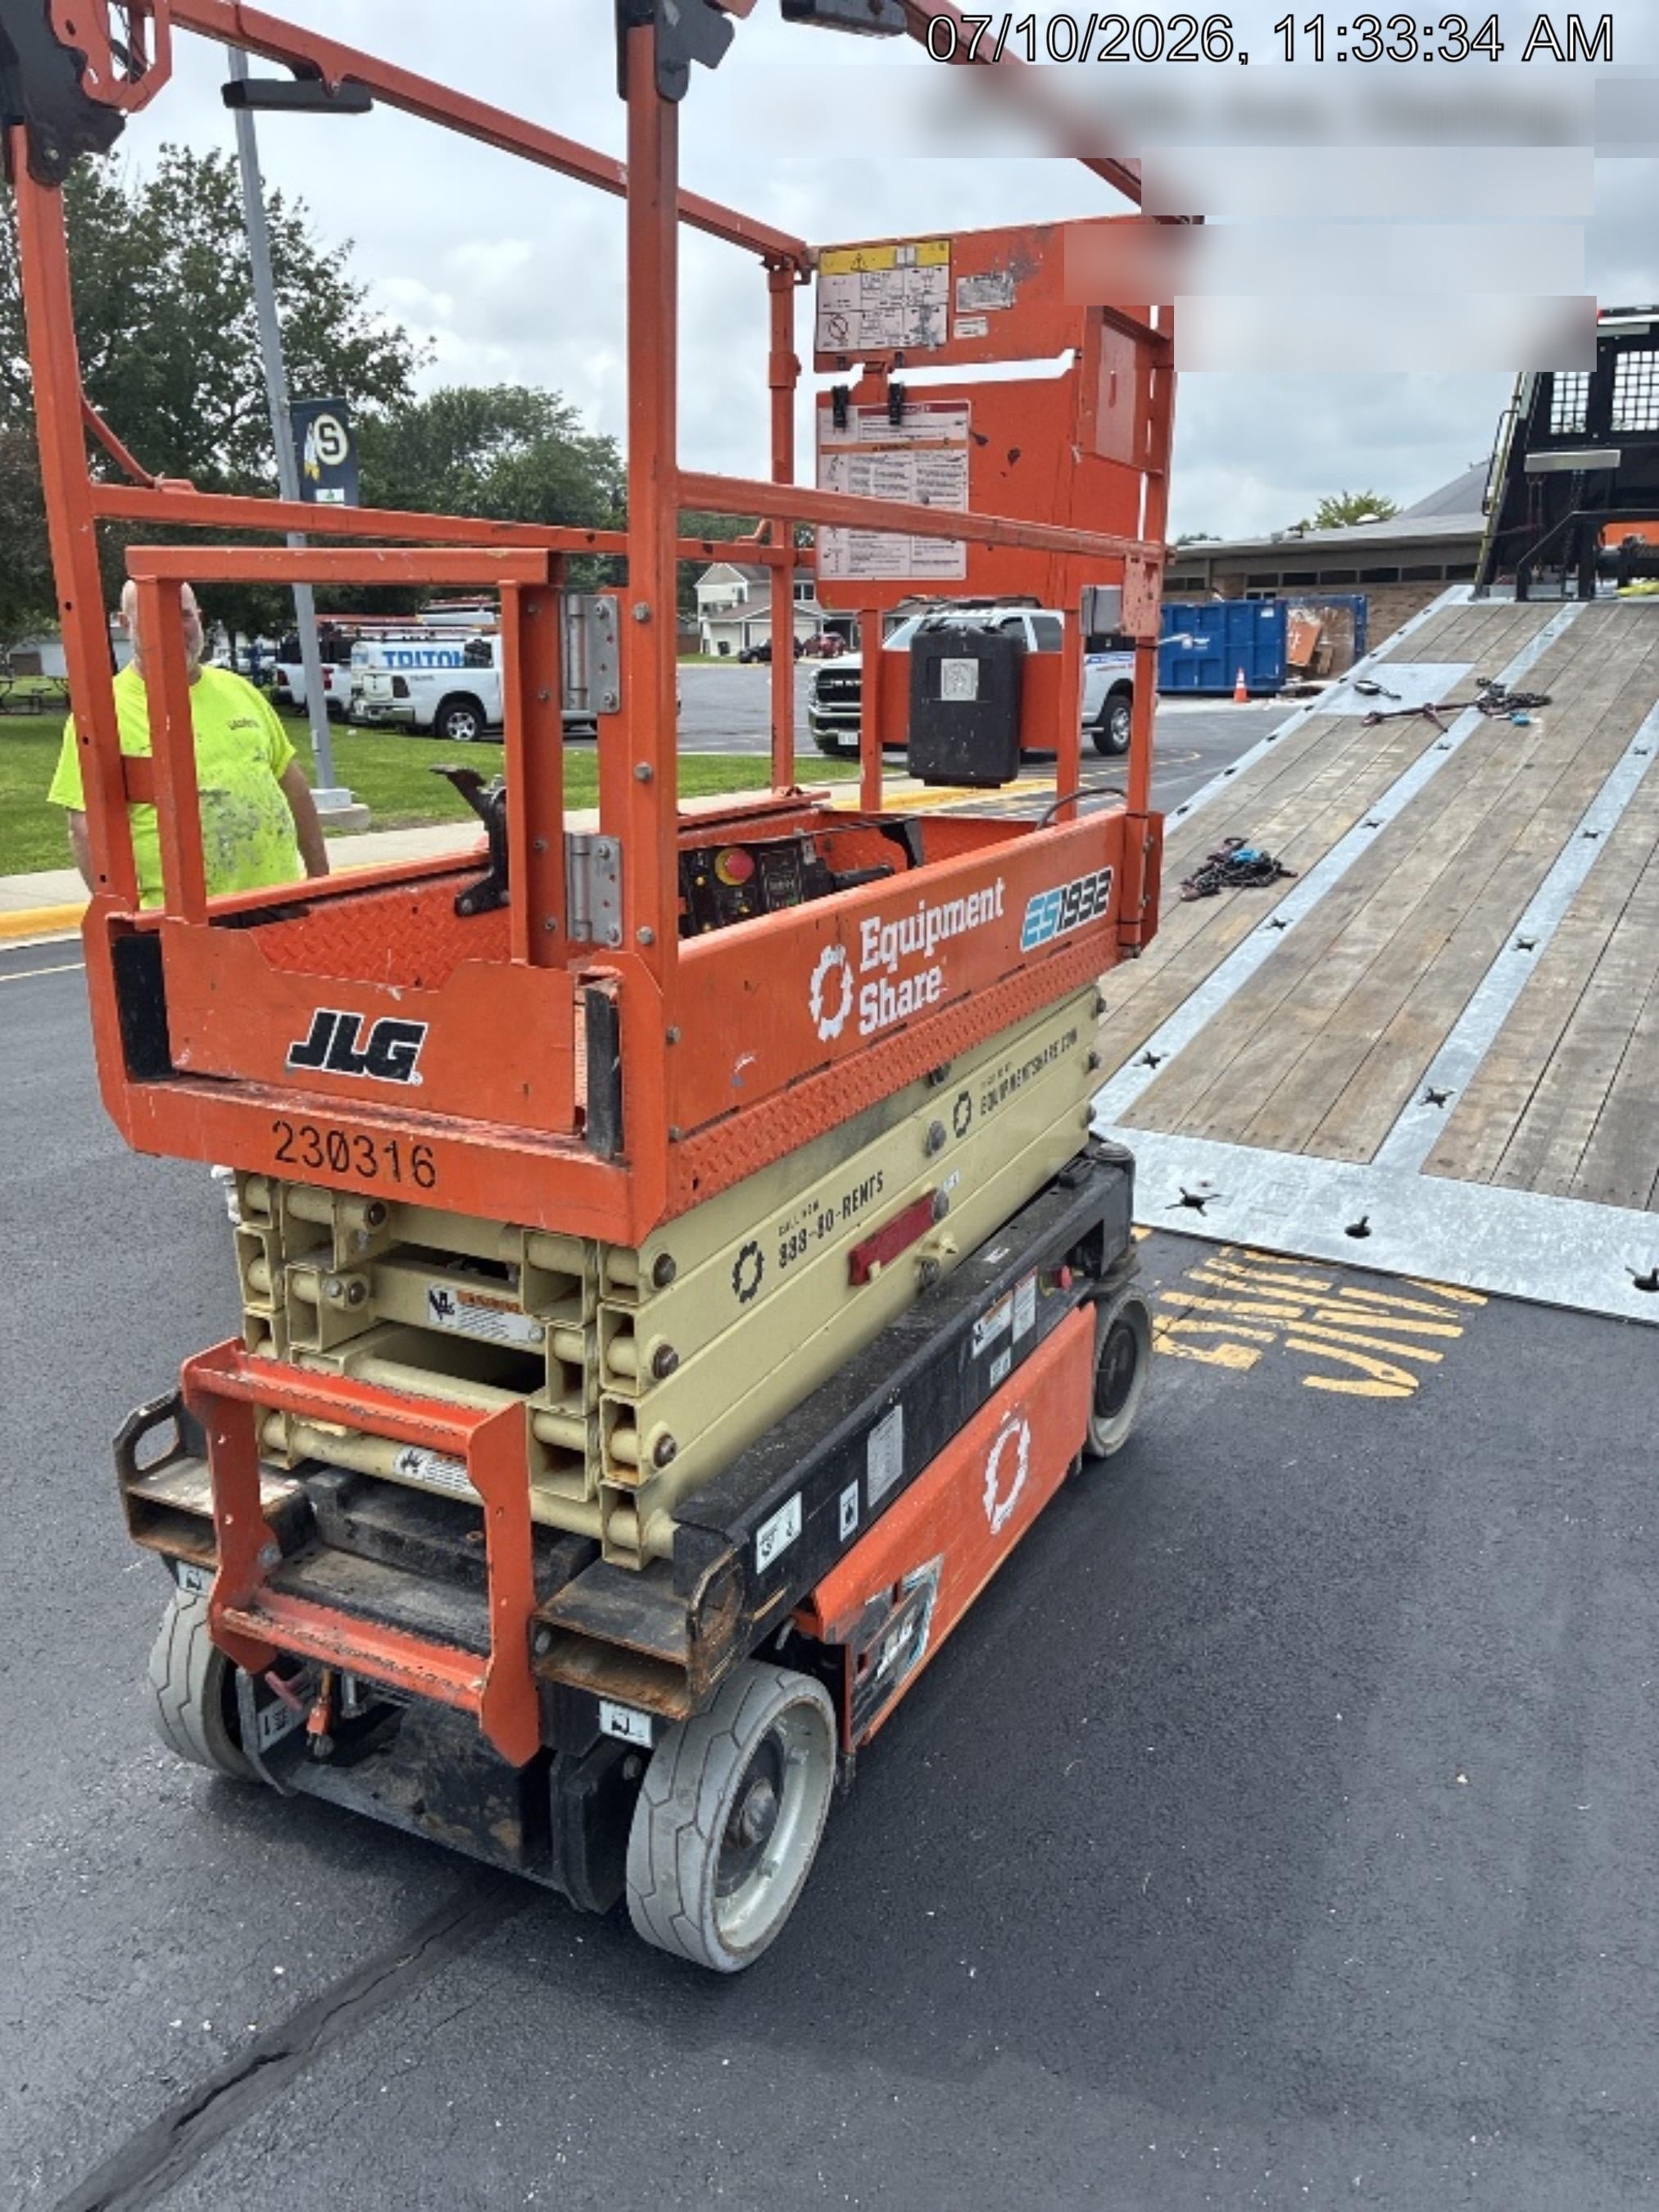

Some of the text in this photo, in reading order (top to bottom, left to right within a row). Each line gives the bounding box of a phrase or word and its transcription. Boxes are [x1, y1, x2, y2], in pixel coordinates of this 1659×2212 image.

[319, 422, 340, 456] S
[859, 877, 1005, 973] Equipment
[859, 964, 944, 1036] Share
[288, 1008, 428, 1085] JLG
[271, 1120, 437, 1189] 230316
